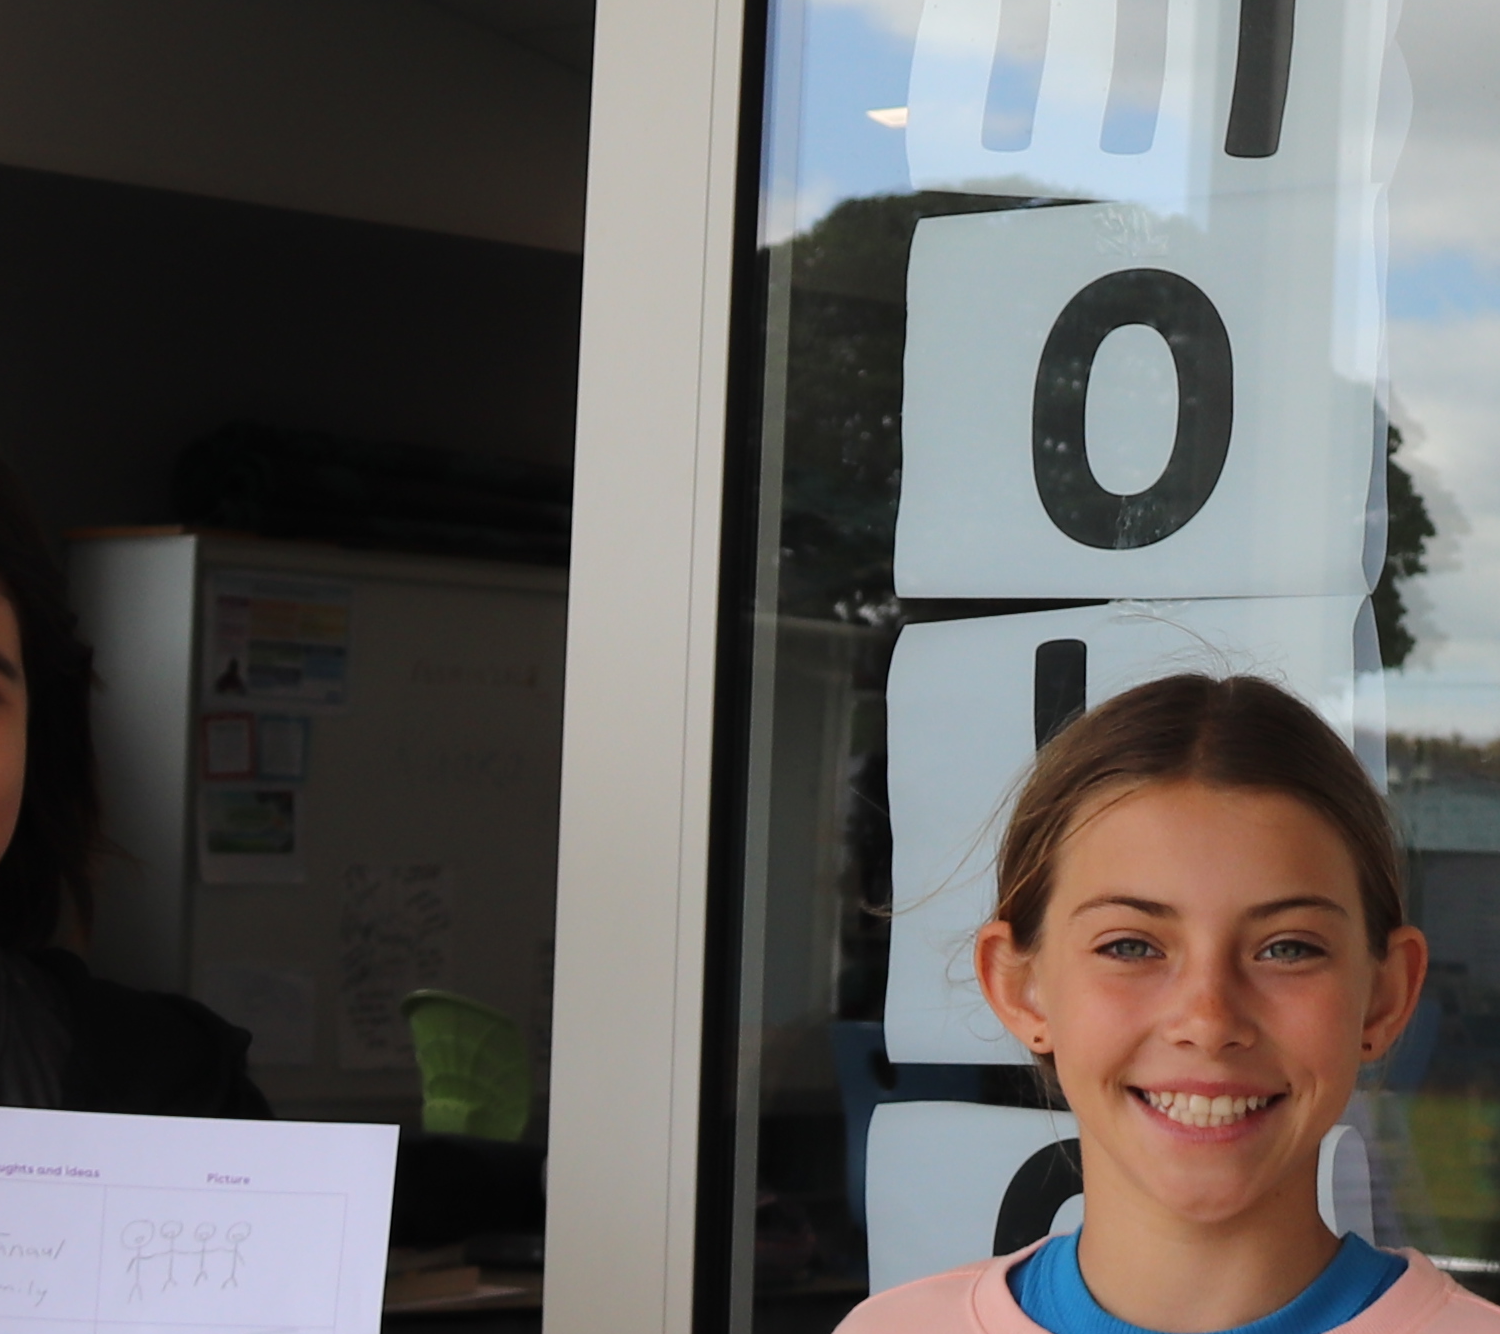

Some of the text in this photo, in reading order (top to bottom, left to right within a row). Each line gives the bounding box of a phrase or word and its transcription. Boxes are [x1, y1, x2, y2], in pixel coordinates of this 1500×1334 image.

[37, 1166, 61, 1176] and
[65, 1167, 100, 1177] ideas
[207, 1173, 250, 1185] Picture
